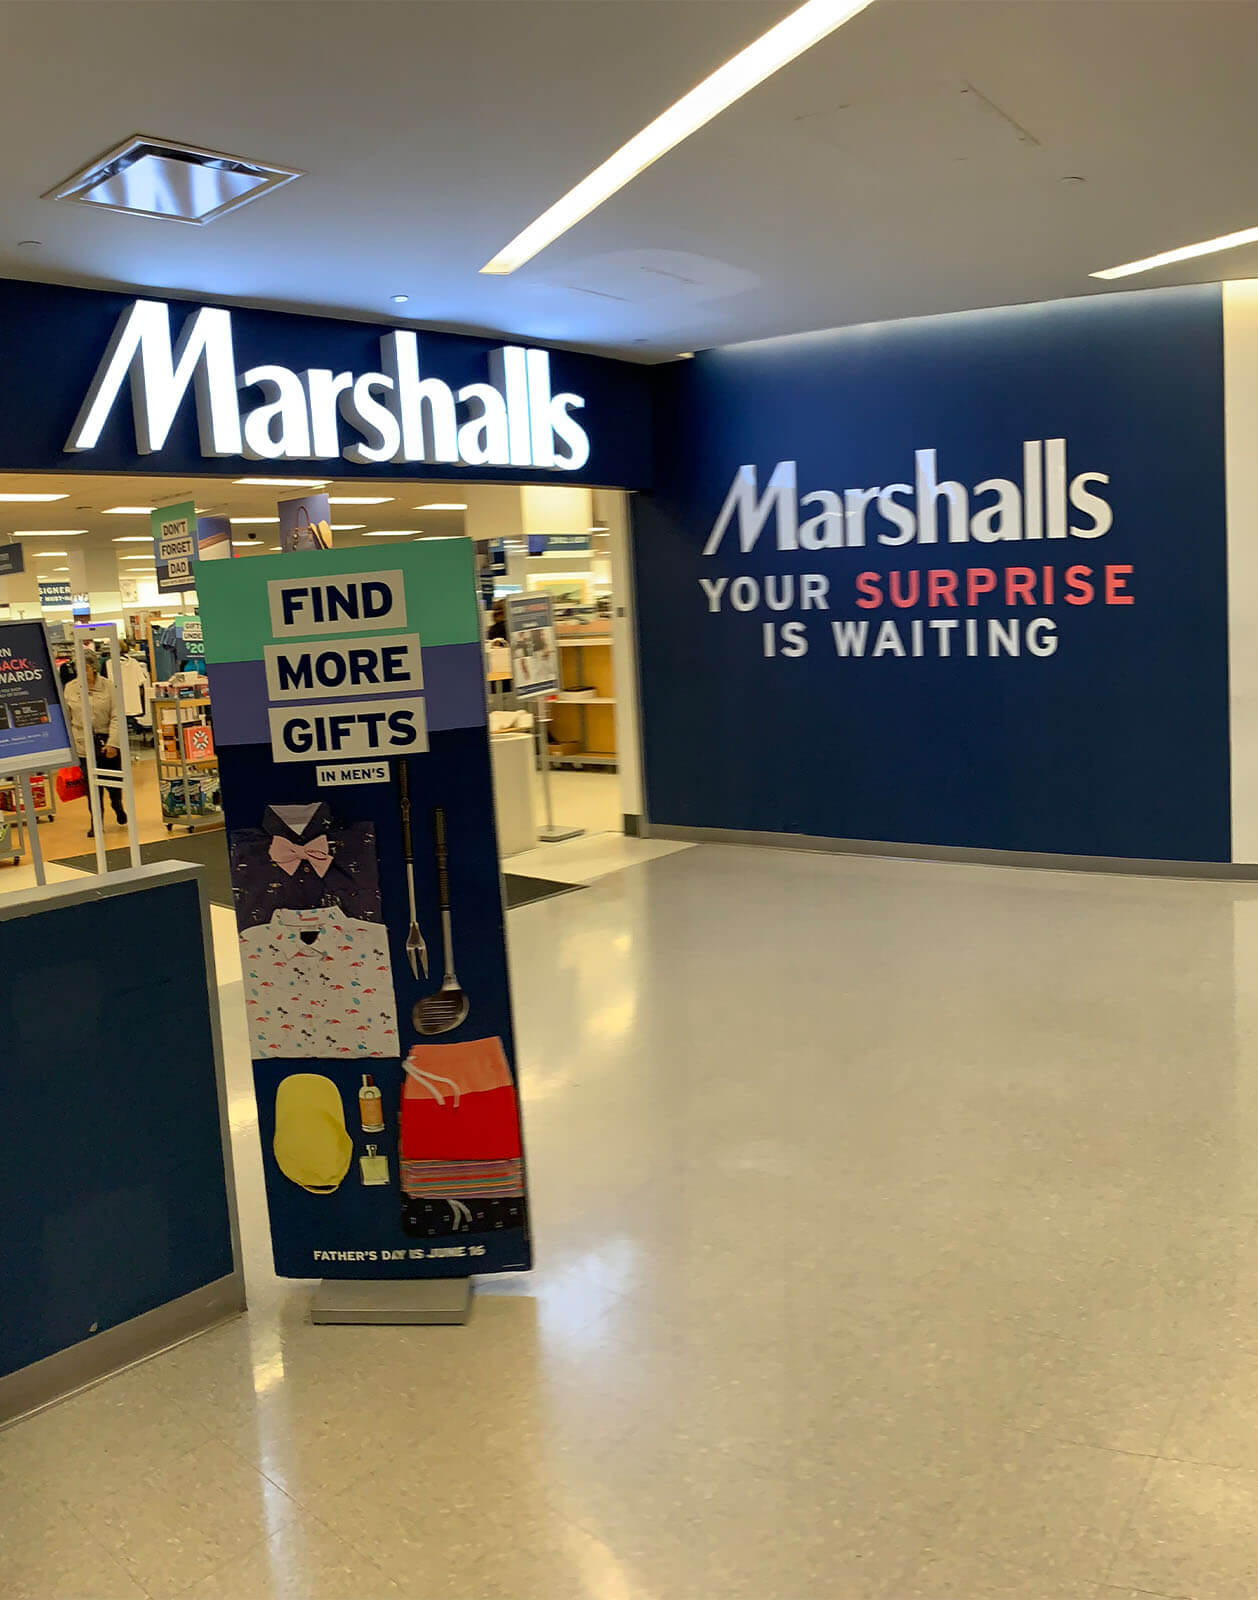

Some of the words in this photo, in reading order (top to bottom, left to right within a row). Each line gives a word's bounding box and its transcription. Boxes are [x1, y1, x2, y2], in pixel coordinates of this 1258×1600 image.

[65, 299, 591, 472] Marshalls
[702, 437, 1114, 556] Marshalls
[162, 521, 186, 537] DON'T
[161, 541, 191, 556] FORGET
[170, 561, 186, 574] DAD
[699, 573, 831, 613] YOUR
[855, 564, 1135, 609] SURPRISE
[280, 581, 393, 625] FIND
[185, 641, 204, 653] $20
[762, 621, 809, 658] IS
[831, 617, 1059, 657] WAITING
[0, 659, 29, 671] ACK
[276, 645, 411, 690] MORE
[282, 710, 417, 754] GIFTS
[320, 771, 336, 782] IN
[341, 768, 385, 781] MEN'S
[313, 1250, 378, 1262] FATHER'S
[381, 1249, 406, 1260] DAY
[408, 1248, 425, 1260] IS
